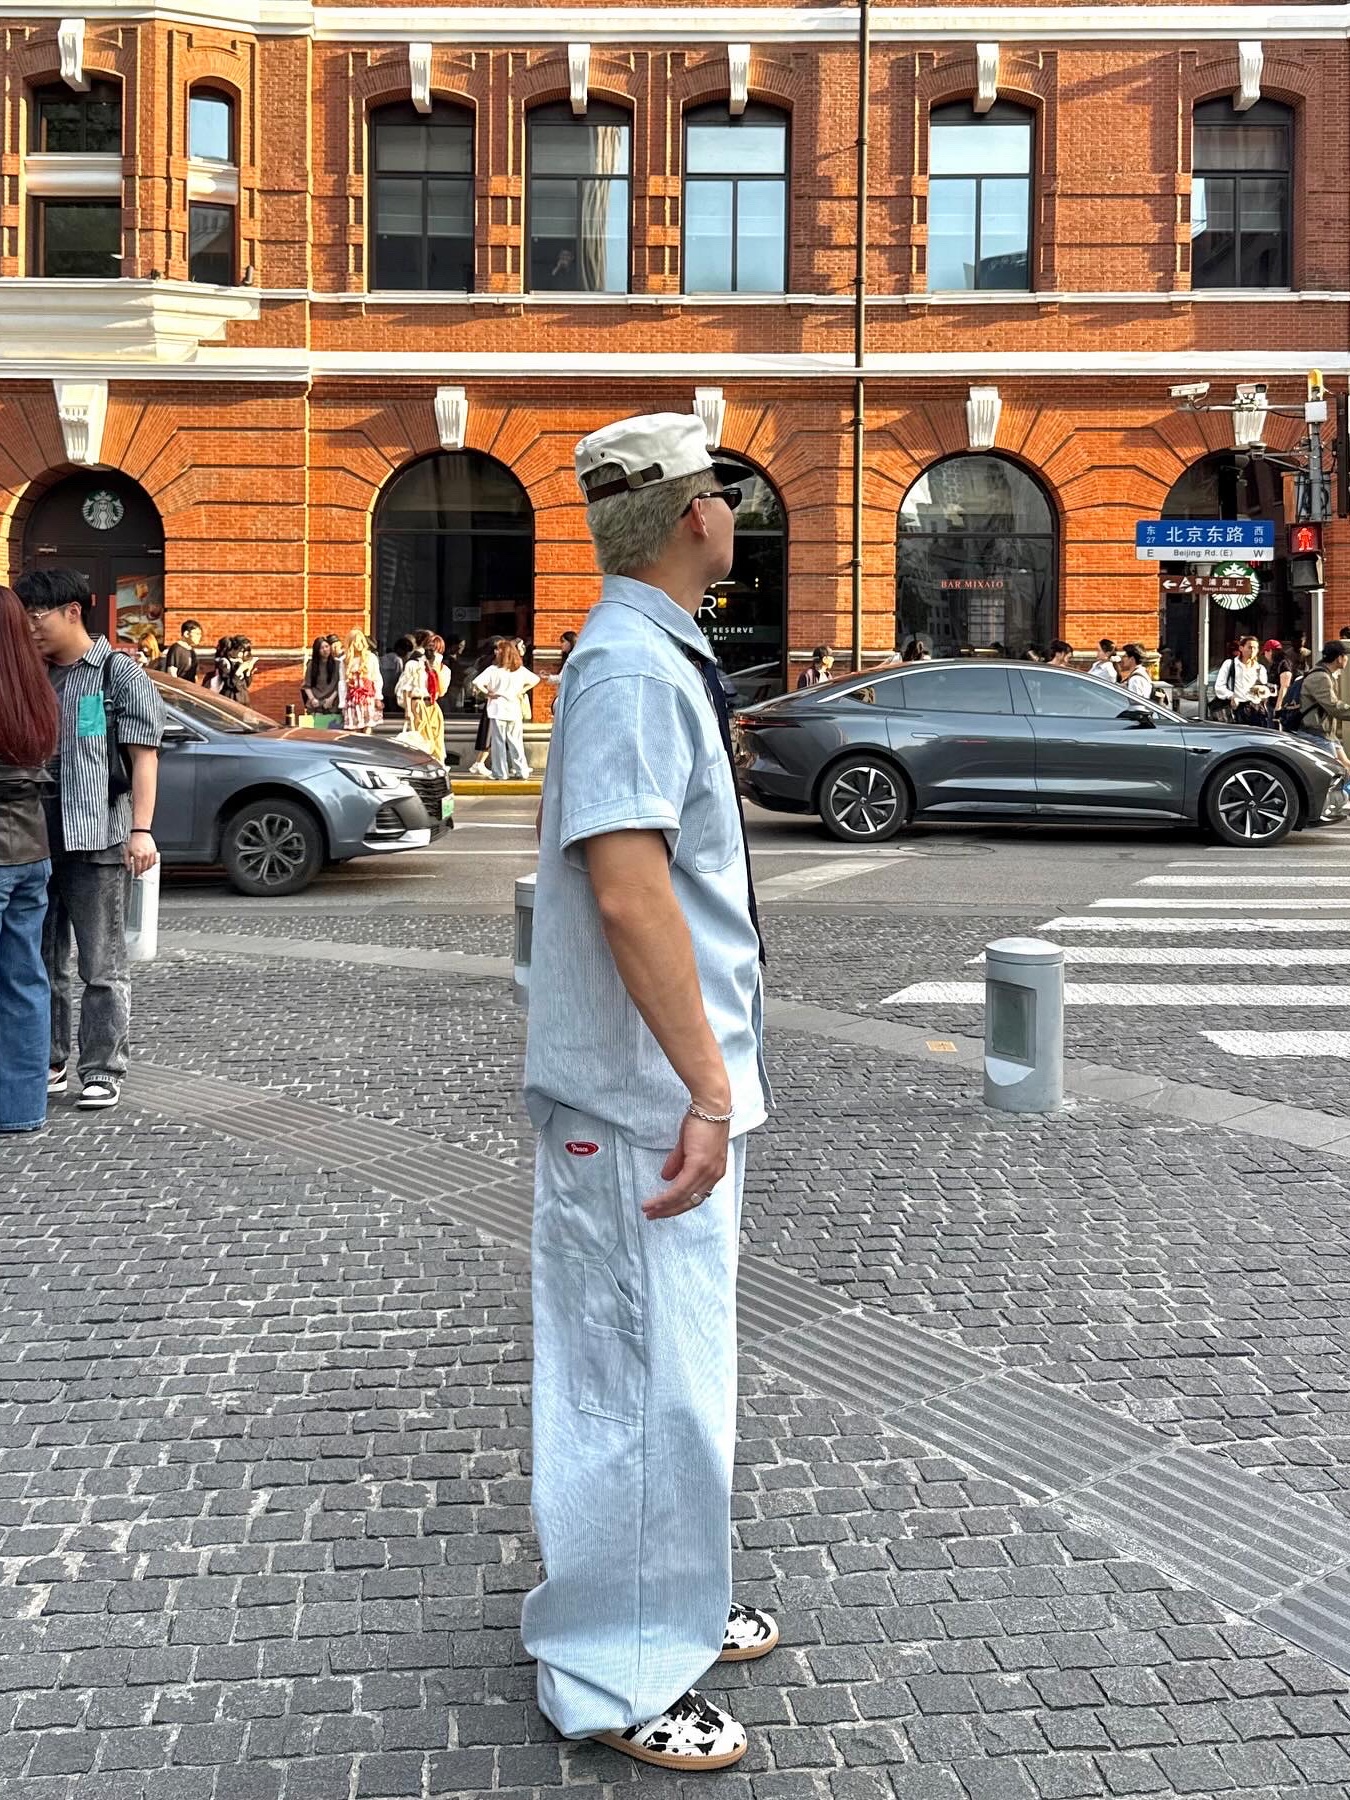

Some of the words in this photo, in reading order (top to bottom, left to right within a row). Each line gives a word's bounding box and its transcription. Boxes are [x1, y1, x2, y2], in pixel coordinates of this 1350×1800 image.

[1146, 525, 1156, 535] 东
[1165, 525, 1244, 544] 北京东路
[1253, 526, 1264, 536] 西
[1146, 549, 1154, 558] E
[1173, 549, 1201, 558] Beijing
[1253, 550, 1264, 558] W
[941, 581, 961, 589] BAR
